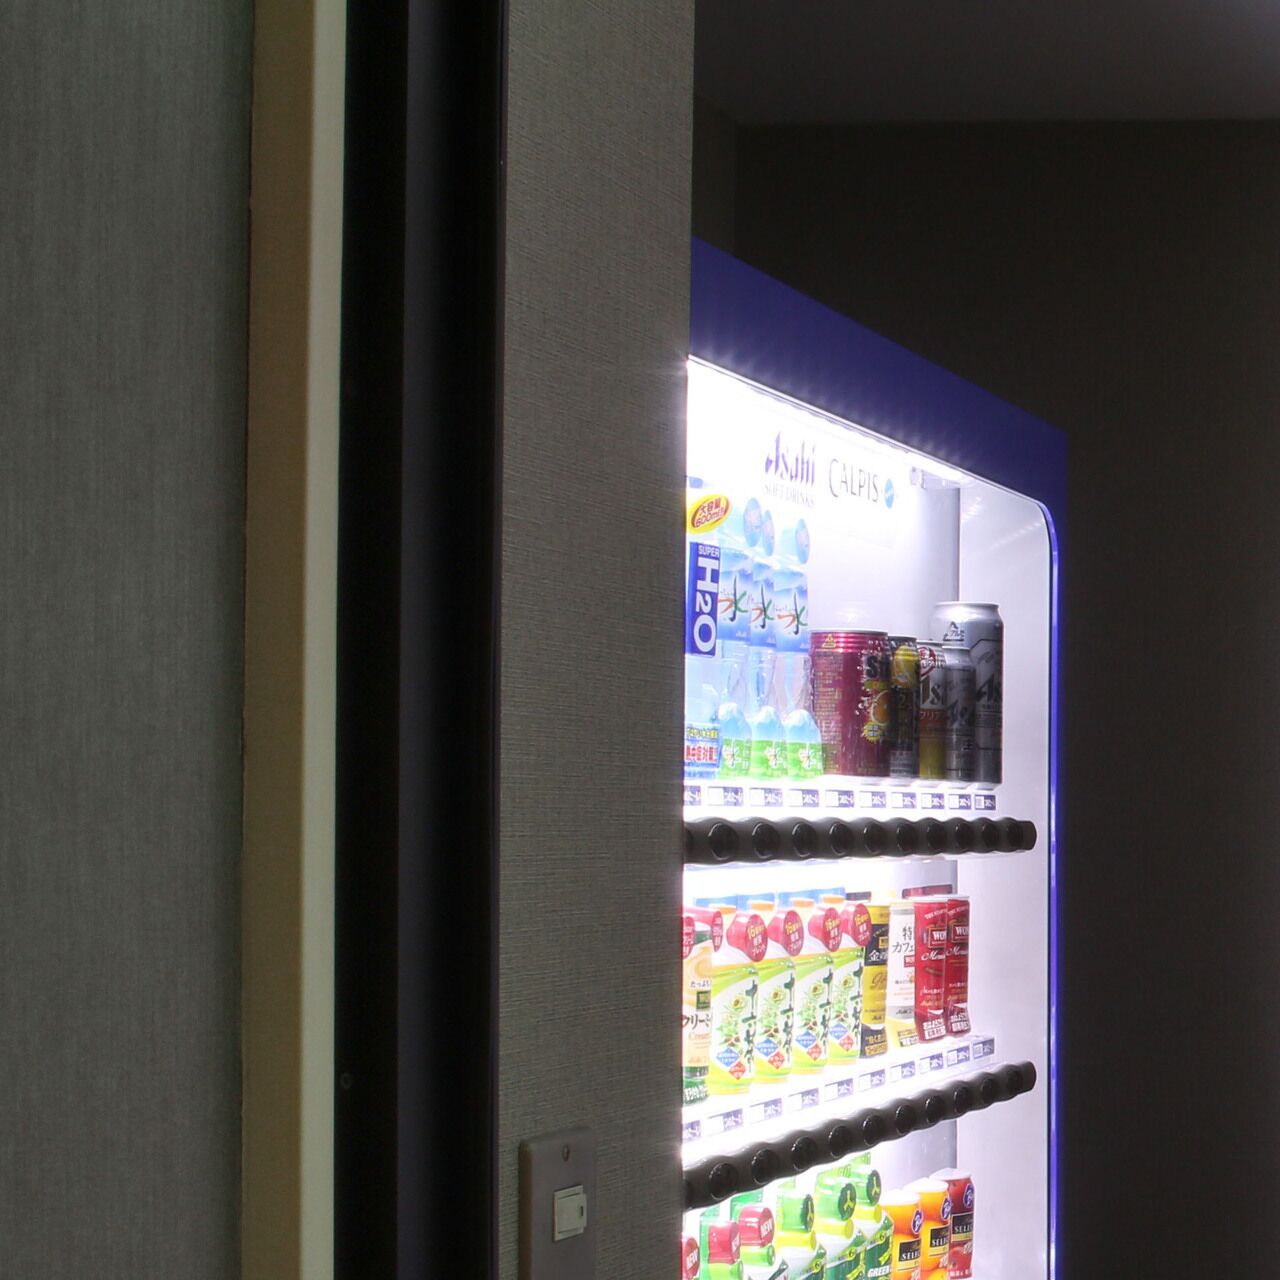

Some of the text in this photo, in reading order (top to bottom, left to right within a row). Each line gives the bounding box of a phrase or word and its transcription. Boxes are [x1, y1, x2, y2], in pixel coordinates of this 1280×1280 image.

[765, 431, 816, 487] Asahi
[828, 458, 879, 503] CALPIS
[698, 544, 720, 558] SUPER
[693, 556, 720, 653] H2O
